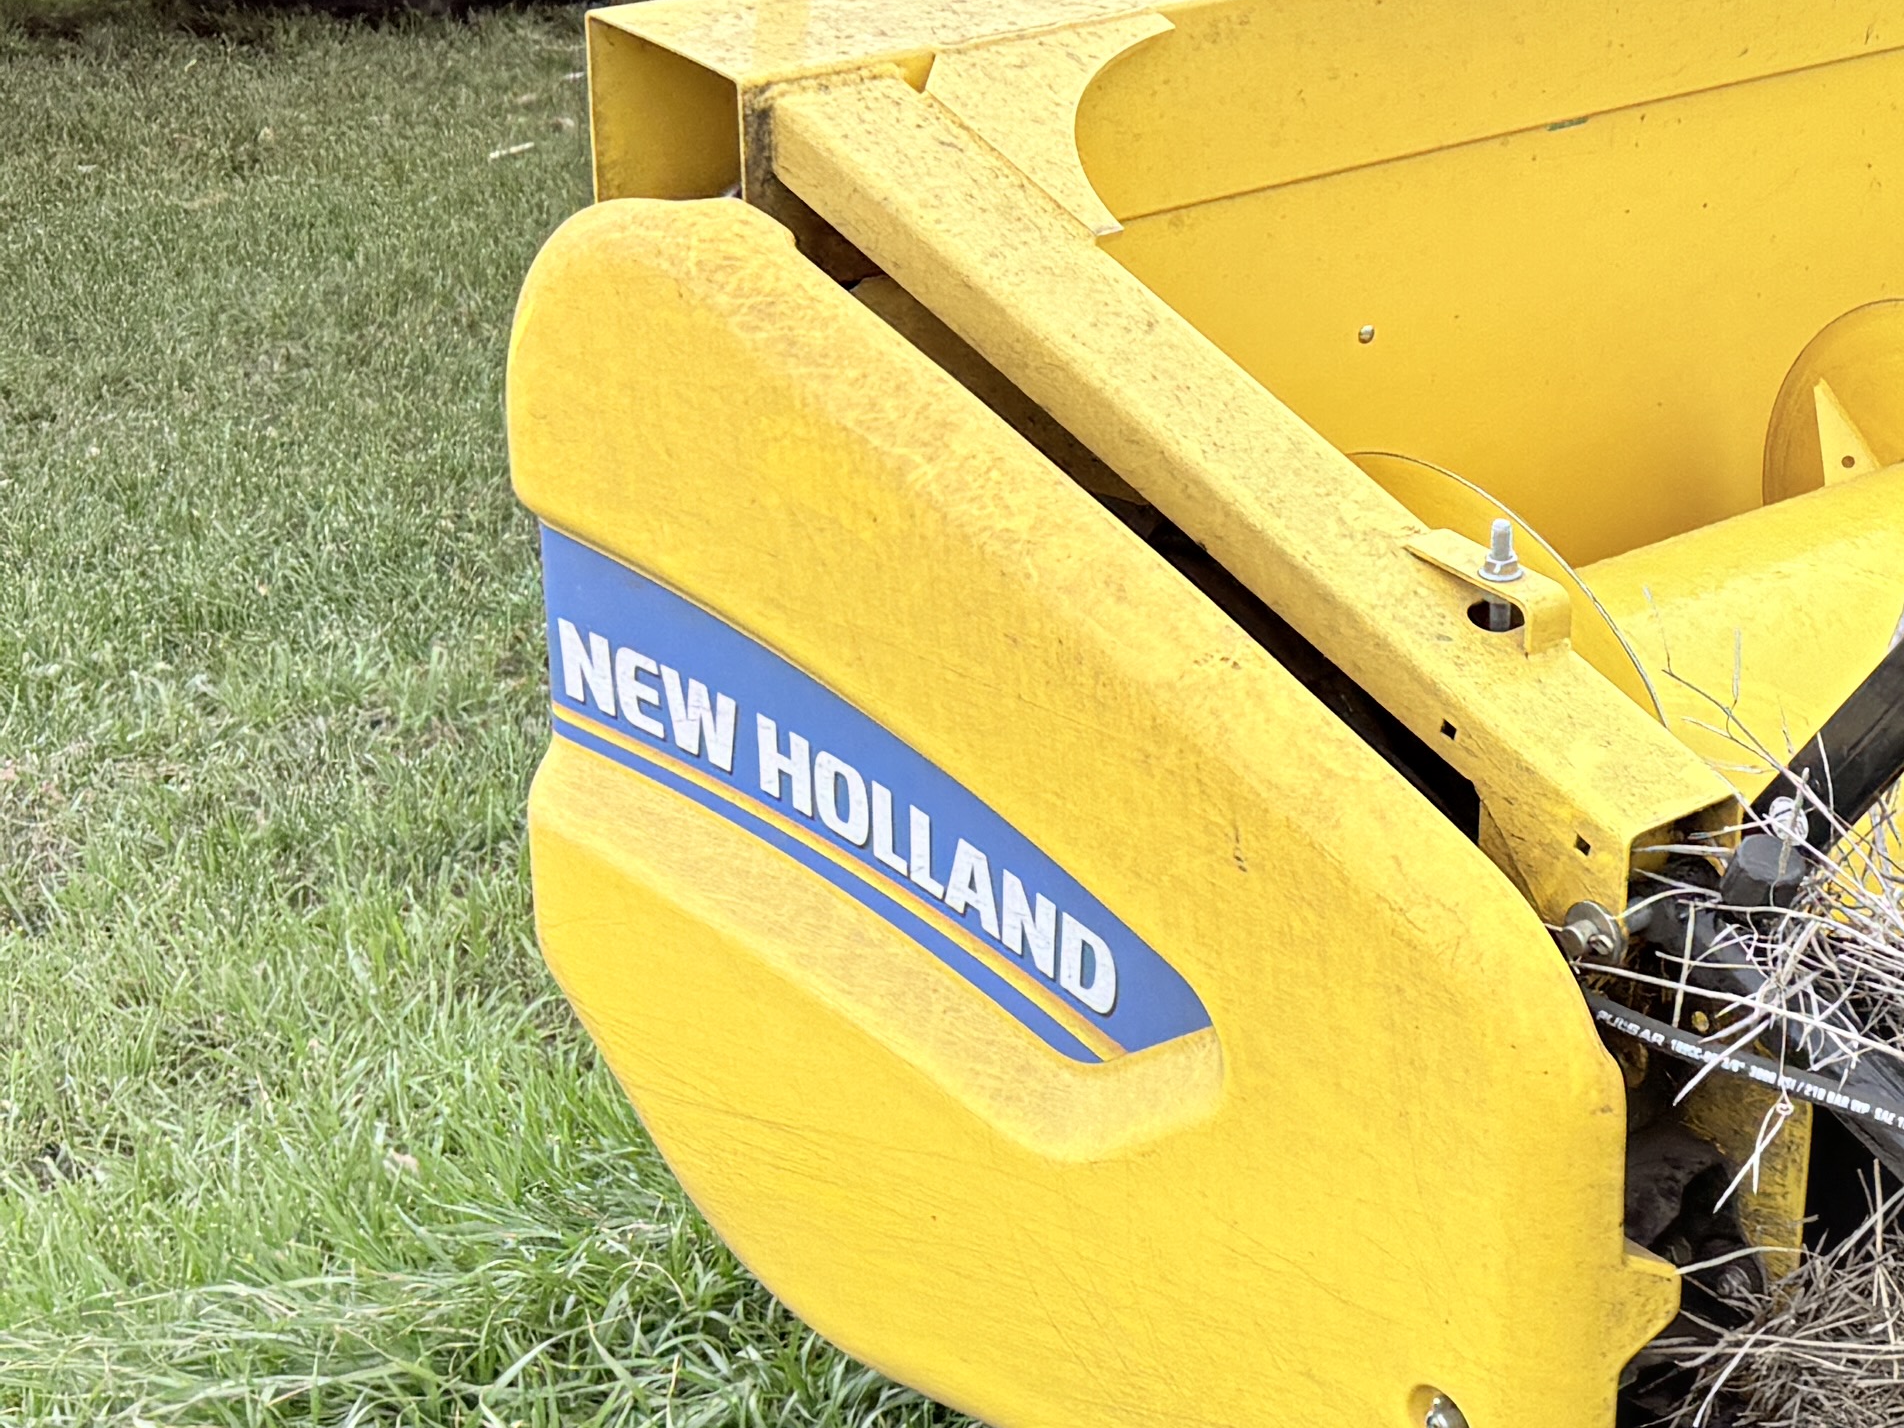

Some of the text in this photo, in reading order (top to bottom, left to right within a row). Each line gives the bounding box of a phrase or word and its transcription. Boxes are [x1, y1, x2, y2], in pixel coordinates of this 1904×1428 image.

[557, 617, 1117, 1015] NEW HOLLAND
[1804, 1083, 1826, 1101] 210
[1826, 1090, 1850, 1109] BAR
[1874, 1107, 1896, 1125] SAE
